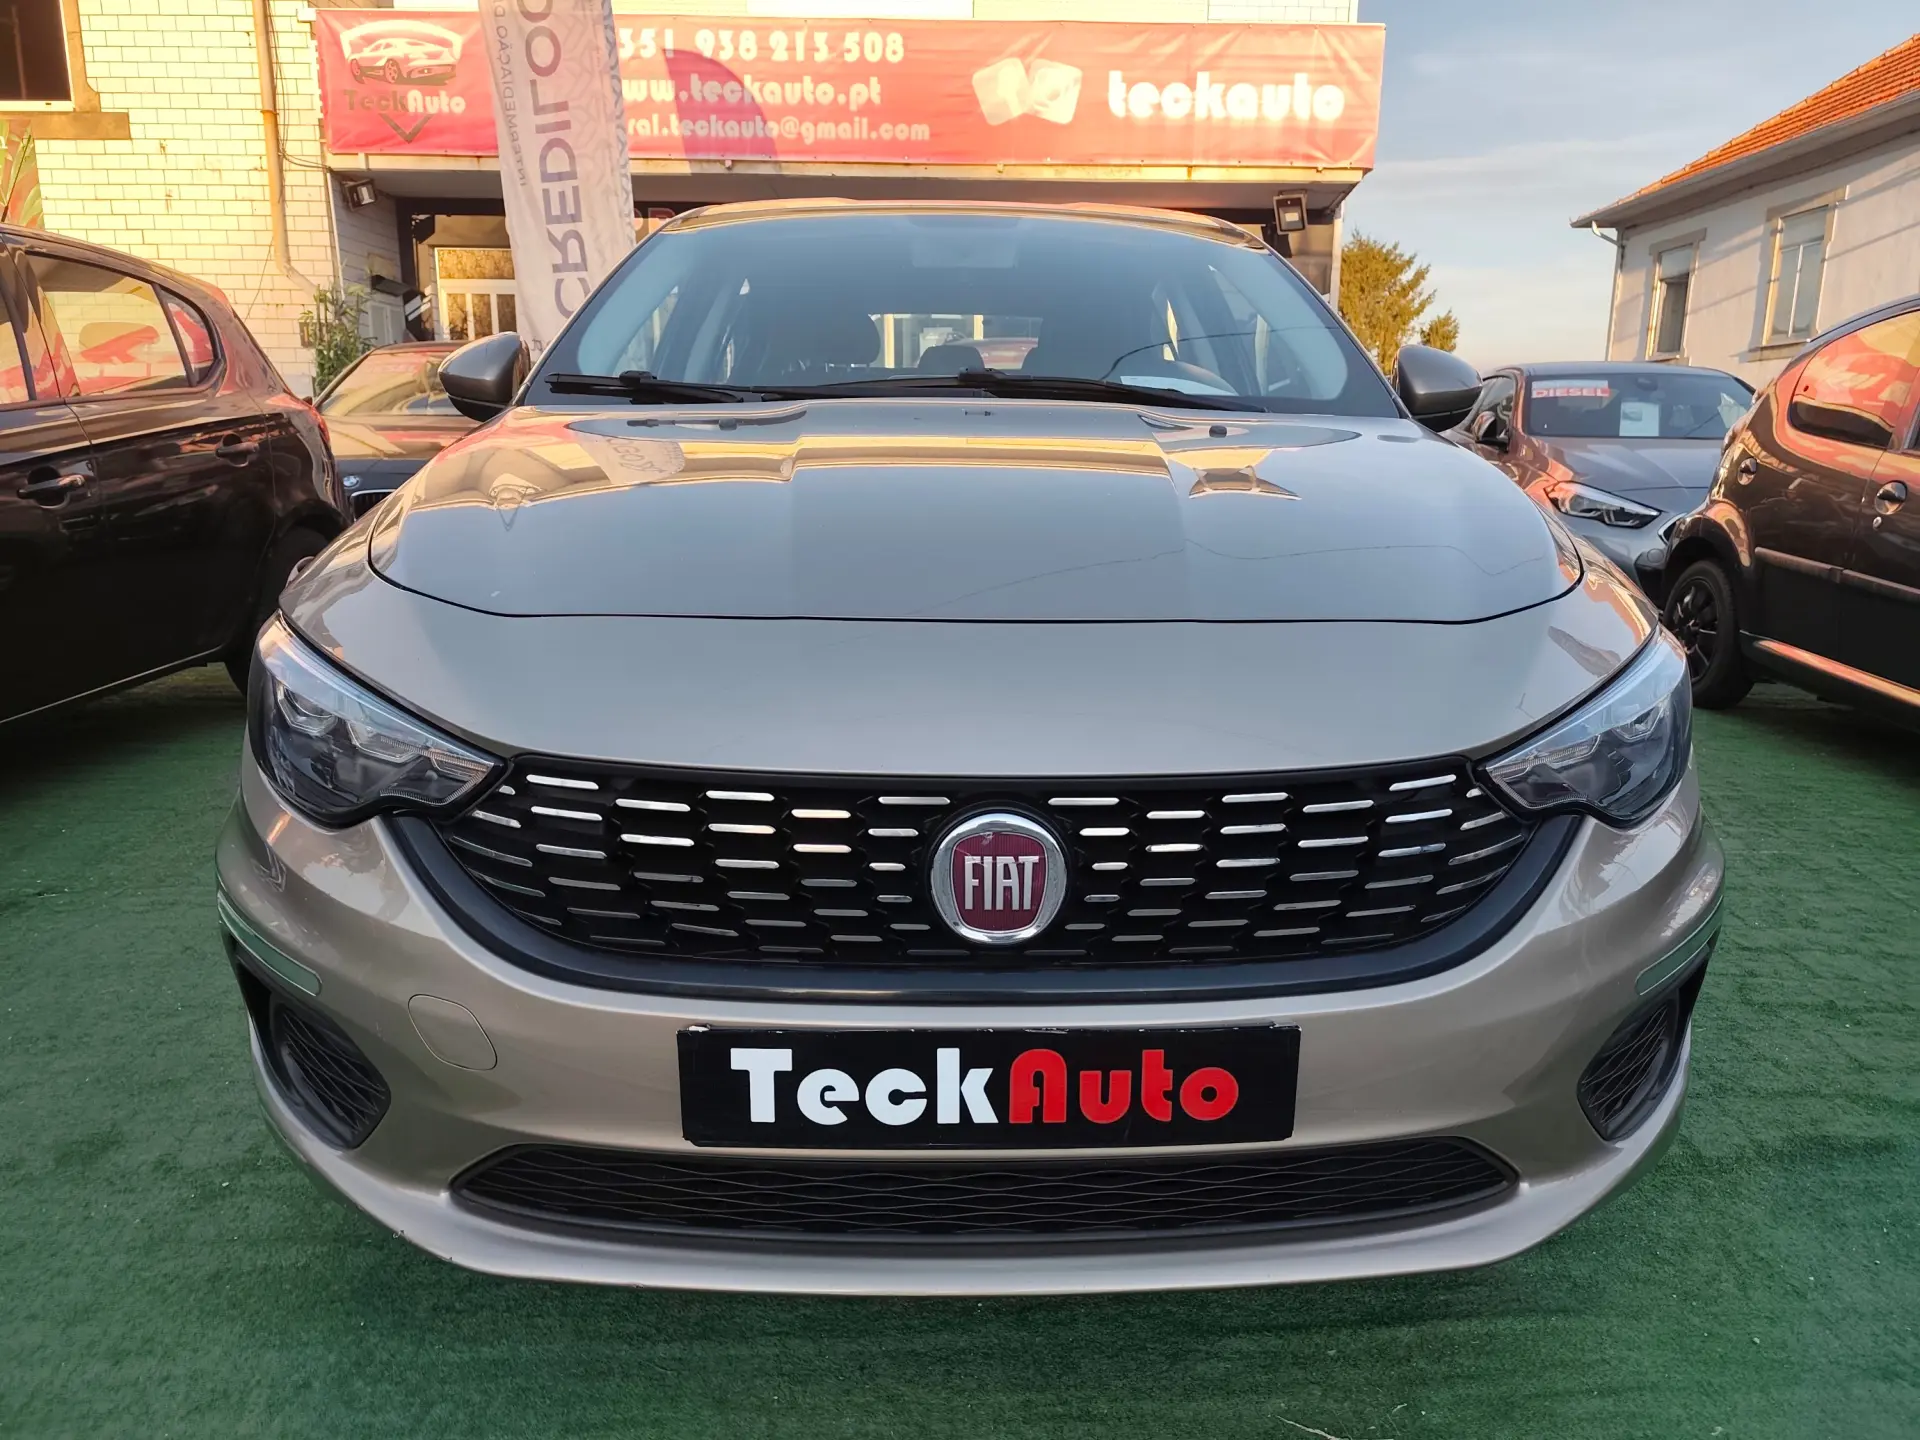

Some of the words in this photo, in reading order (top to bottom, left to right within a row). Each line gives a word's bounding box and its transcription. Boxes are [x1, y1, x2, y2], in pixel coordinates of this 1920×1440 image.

[694, 29, 758, 62] 938
[768, 30, 830, 63] 213
[843, 31, 905, 63] 508
[343, 89, 466, 114] TeckAuto
[1107, 69, 1346, 122] teckauto
[1533, 387, 1611, 397] DIESEL
[964, 855, 1040, 911] FIAT
[730, 1047, 1240, 1126] TeckAuto
